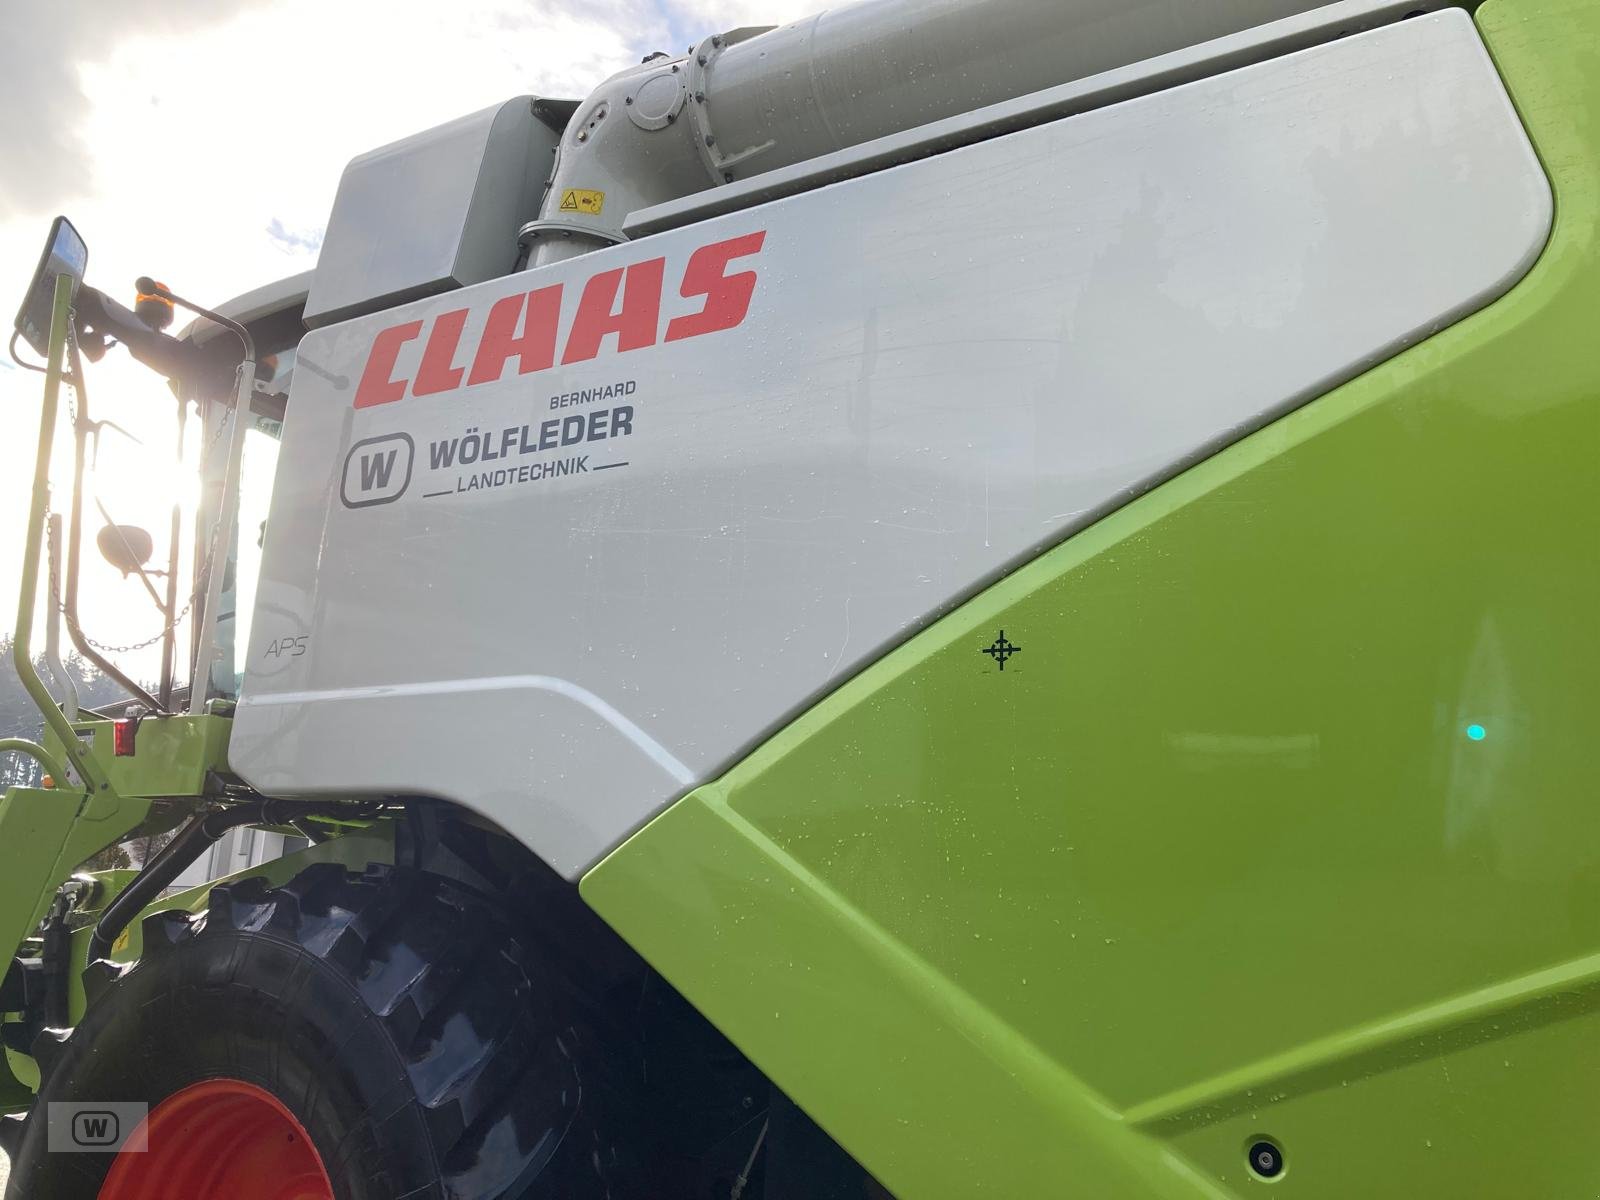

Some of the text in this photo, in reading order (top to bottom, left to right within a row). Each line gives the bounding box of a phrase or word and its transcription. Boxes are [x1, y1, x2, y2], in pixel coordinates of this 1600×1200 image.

[354, 231, 767, 409] CLAAS
[550, 380, 636, 410] BERNHARD
[430, 406, 633, 469] WÖLFLEDER
[361, 451, 396, 490] W
[457, 456, 588, 492] LANDTECHNIK
[265, 637, 308, 657] APS
